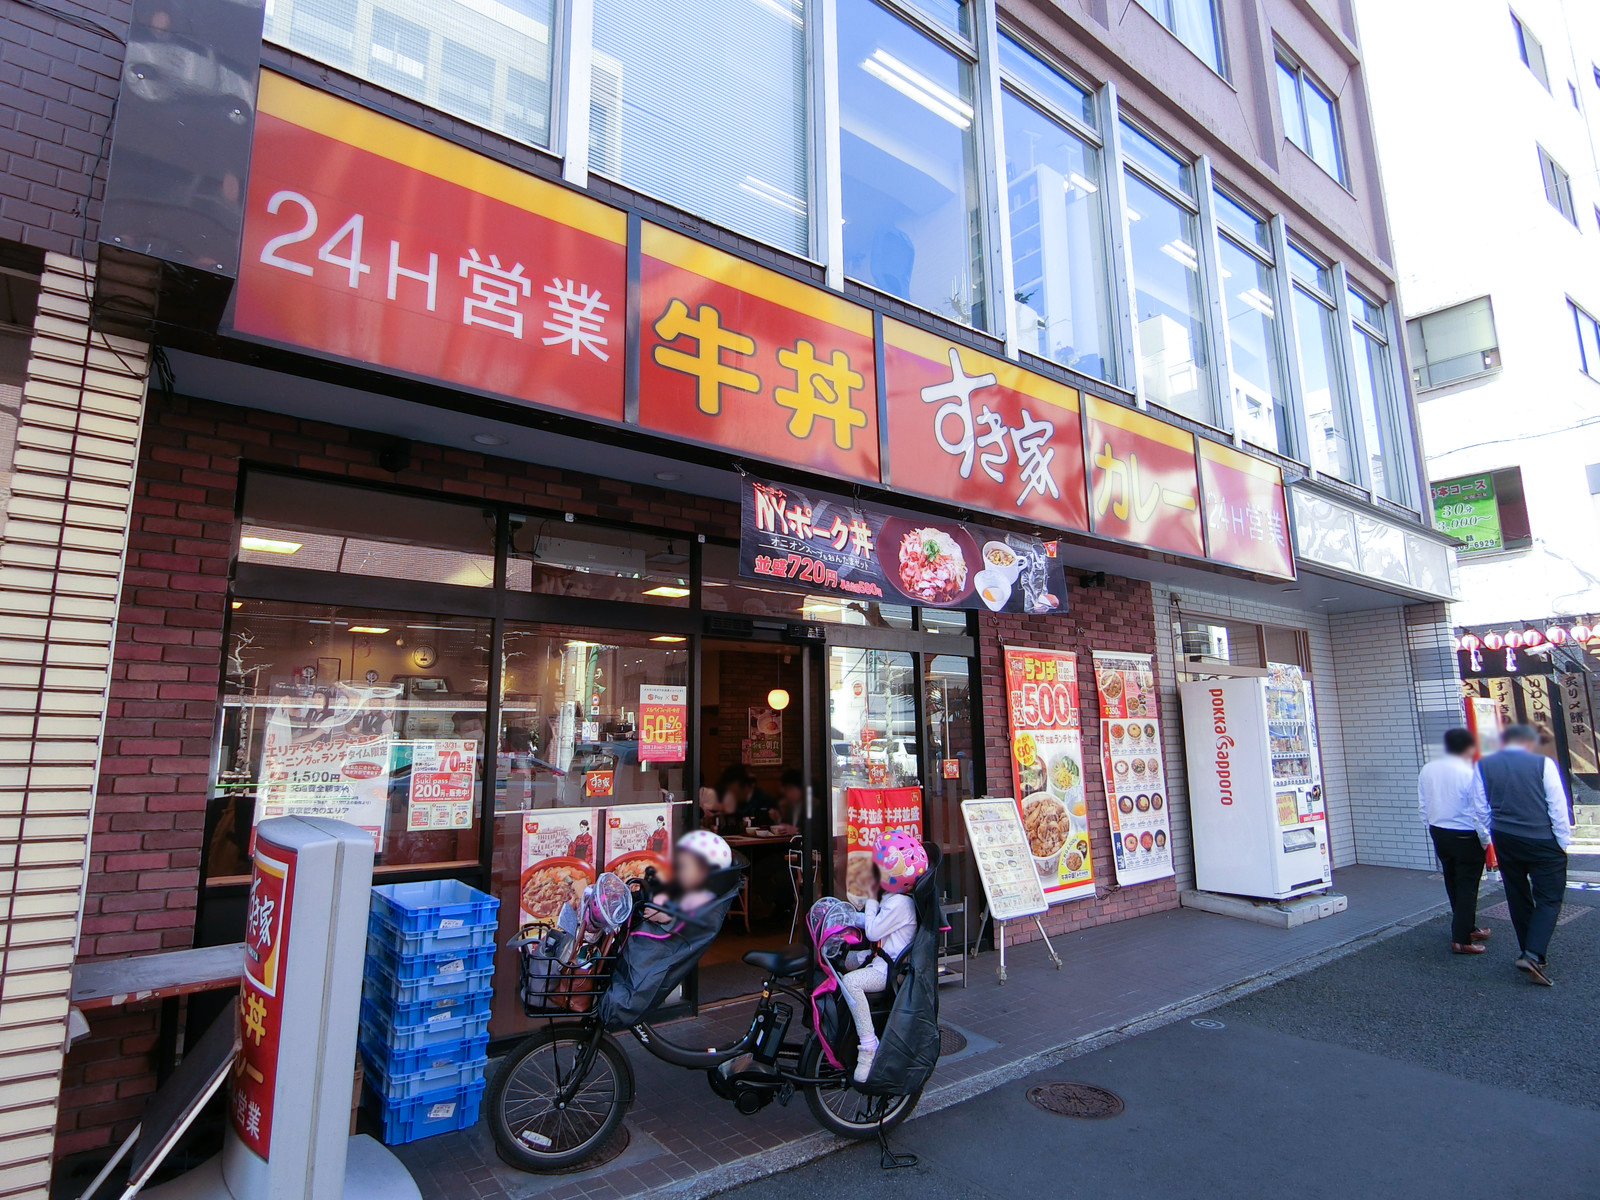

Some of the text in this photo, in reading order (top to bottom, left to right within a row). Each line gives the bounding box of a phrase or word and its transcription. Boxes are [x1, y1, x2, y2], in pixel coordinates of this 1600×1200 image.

[259, 190, 611, 363] 24H営業
[652, 298, 868, 450] 牛丼
[920, 347, 1060, 506] すき家
[1094, 442, 1197, 523] カレー
[754, 488, 875, 560] NYポーク丼
[754, 553, 838, 588] 並盛720円
[1024, 657, 1057, 681] ランチ
